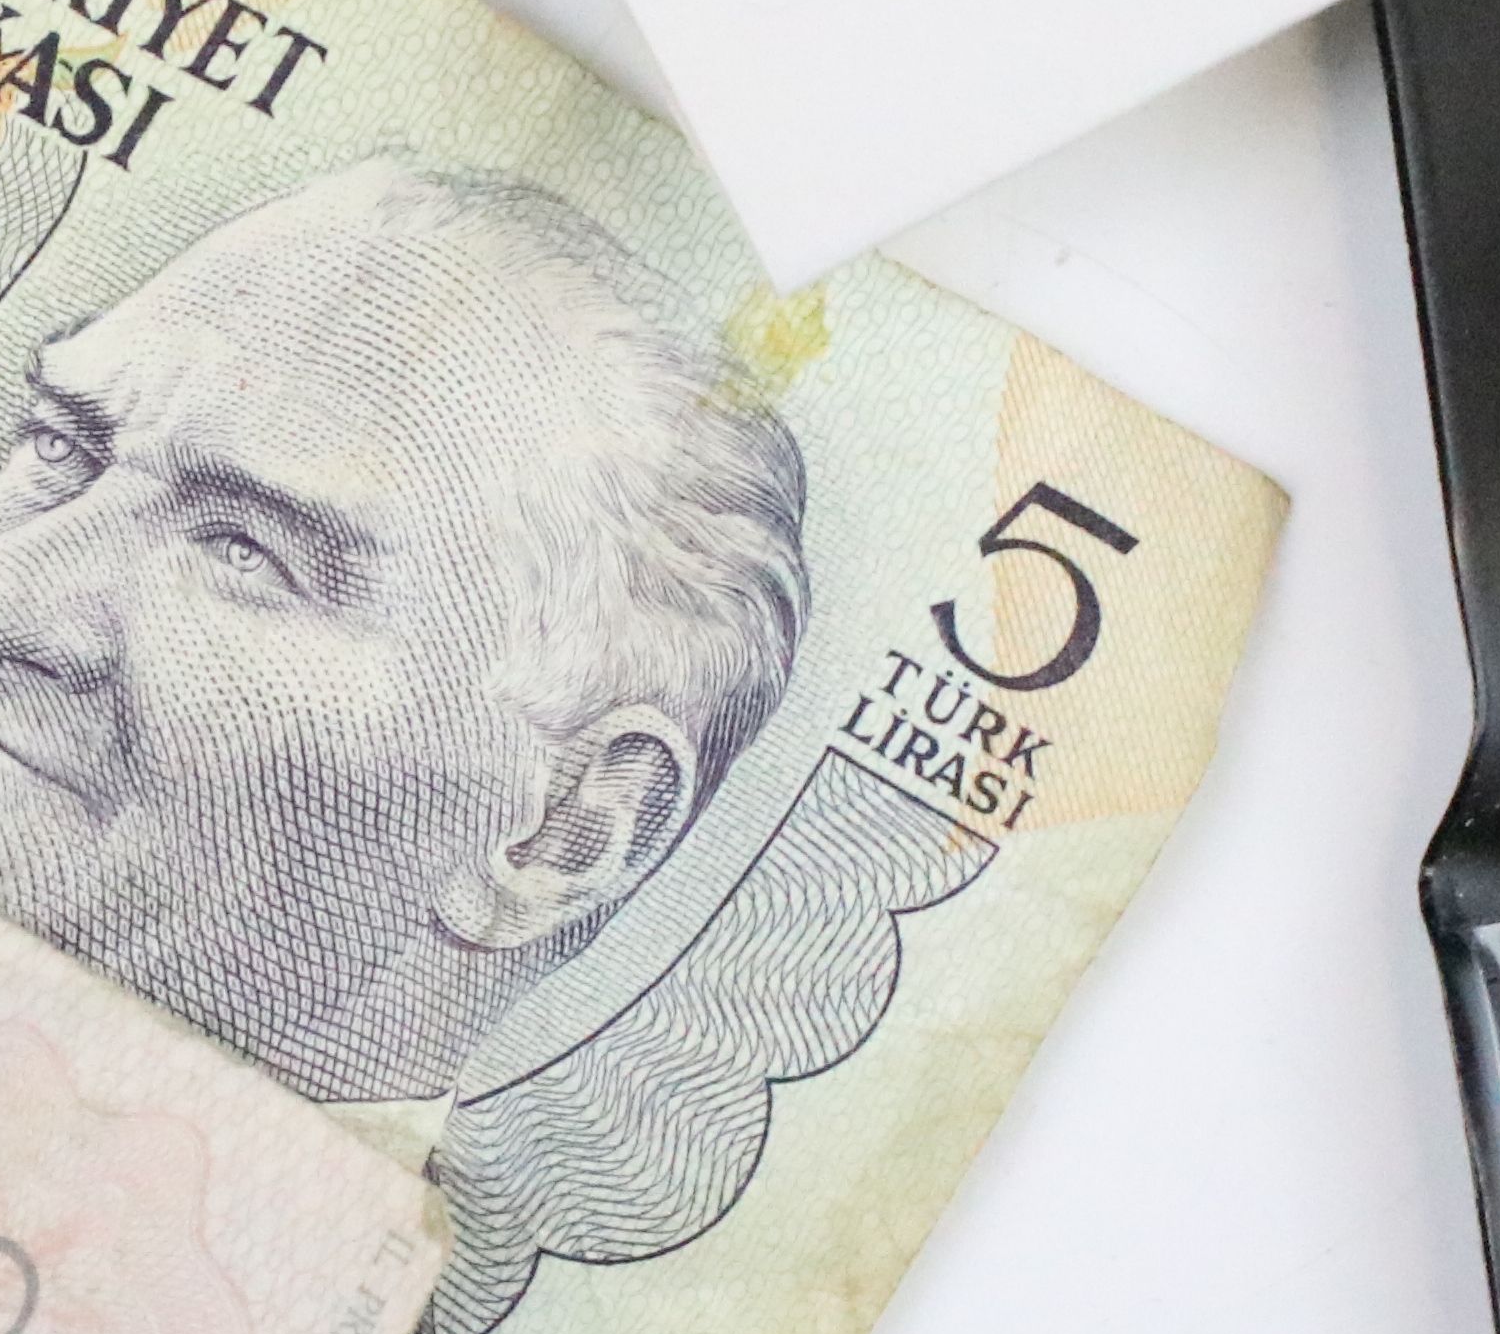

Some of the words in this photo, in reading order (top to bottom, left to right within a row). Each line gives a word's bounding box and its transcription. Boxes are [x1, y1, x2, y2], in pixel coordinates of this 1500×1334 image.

[929, 481, 1140, 692] 5
[839, 694, 1036, 830] LİRASI
[881, 649, 1053, 778] TÜRK
